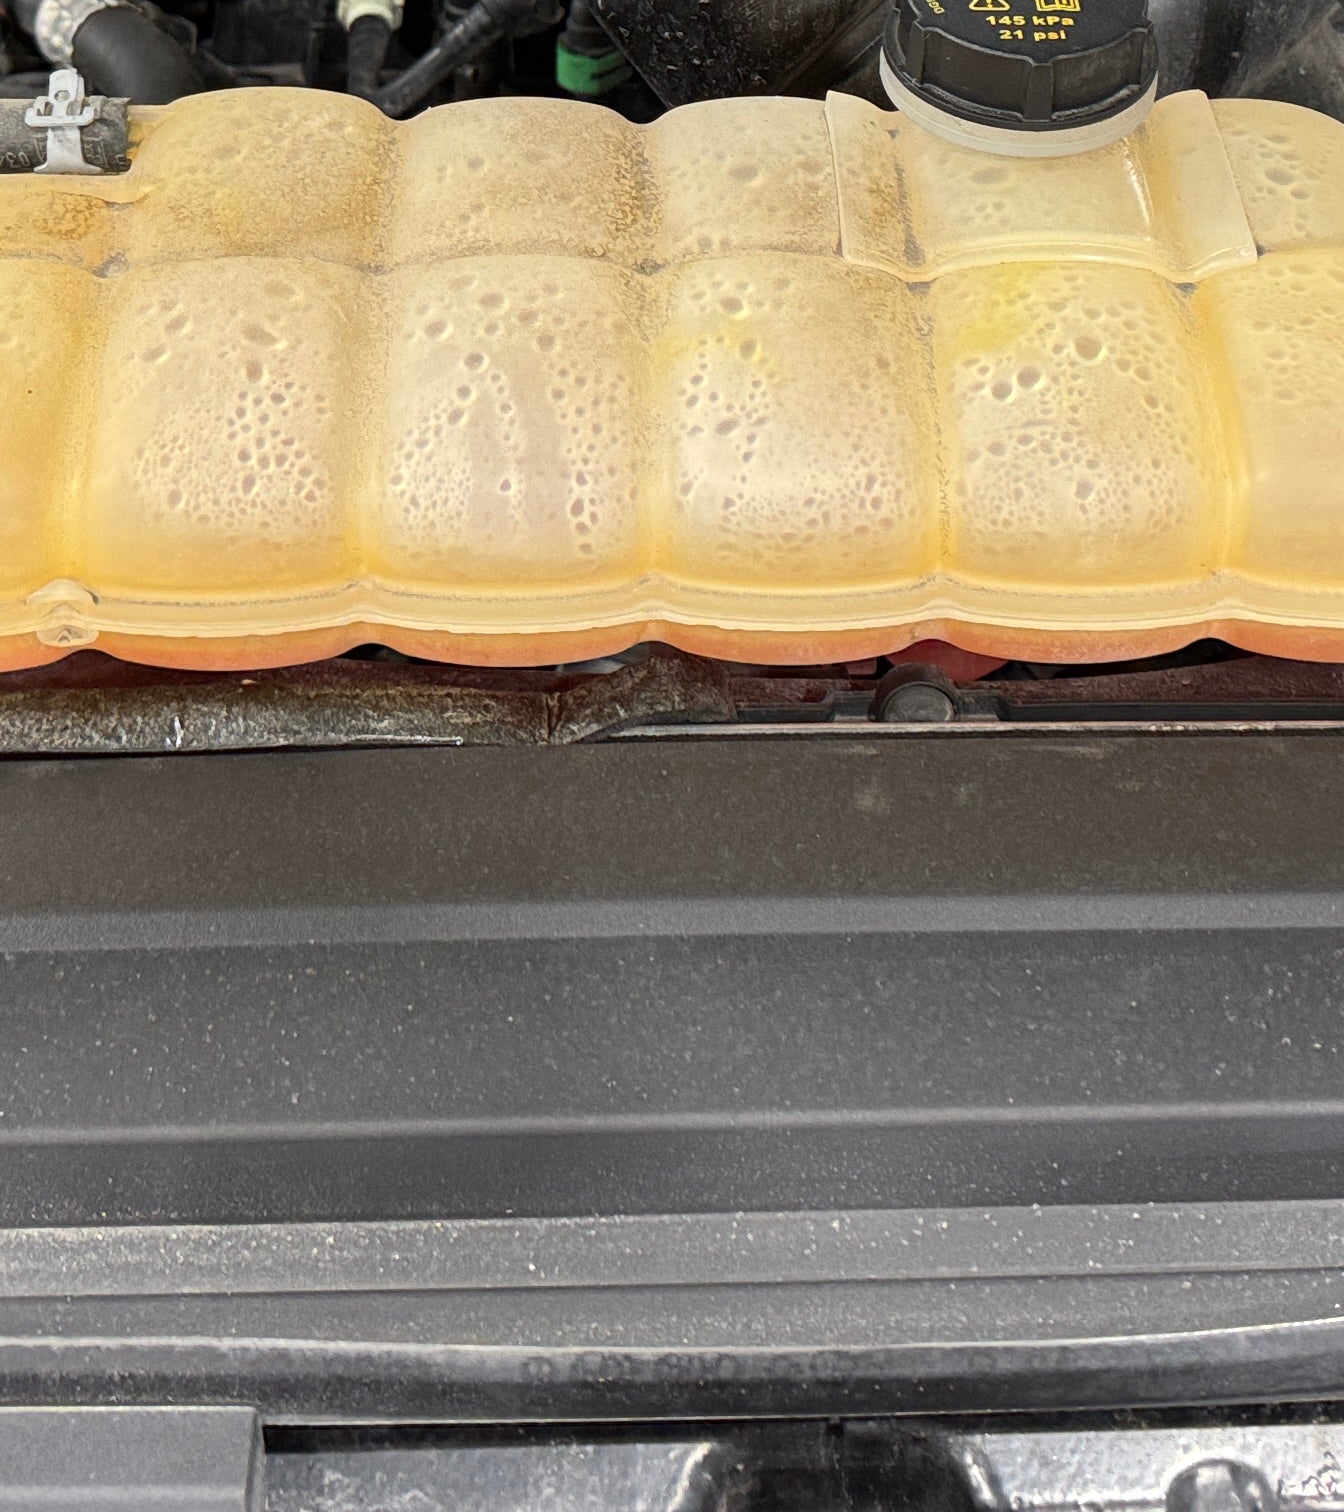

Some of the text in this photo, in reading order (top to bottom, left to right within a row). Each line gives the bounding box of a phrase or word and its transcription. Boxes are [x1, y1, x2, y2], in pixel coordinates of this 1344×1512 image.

[986, 15, 1075, 26] 145 kPa
[999, 29, 1066, 42] 21 psi
